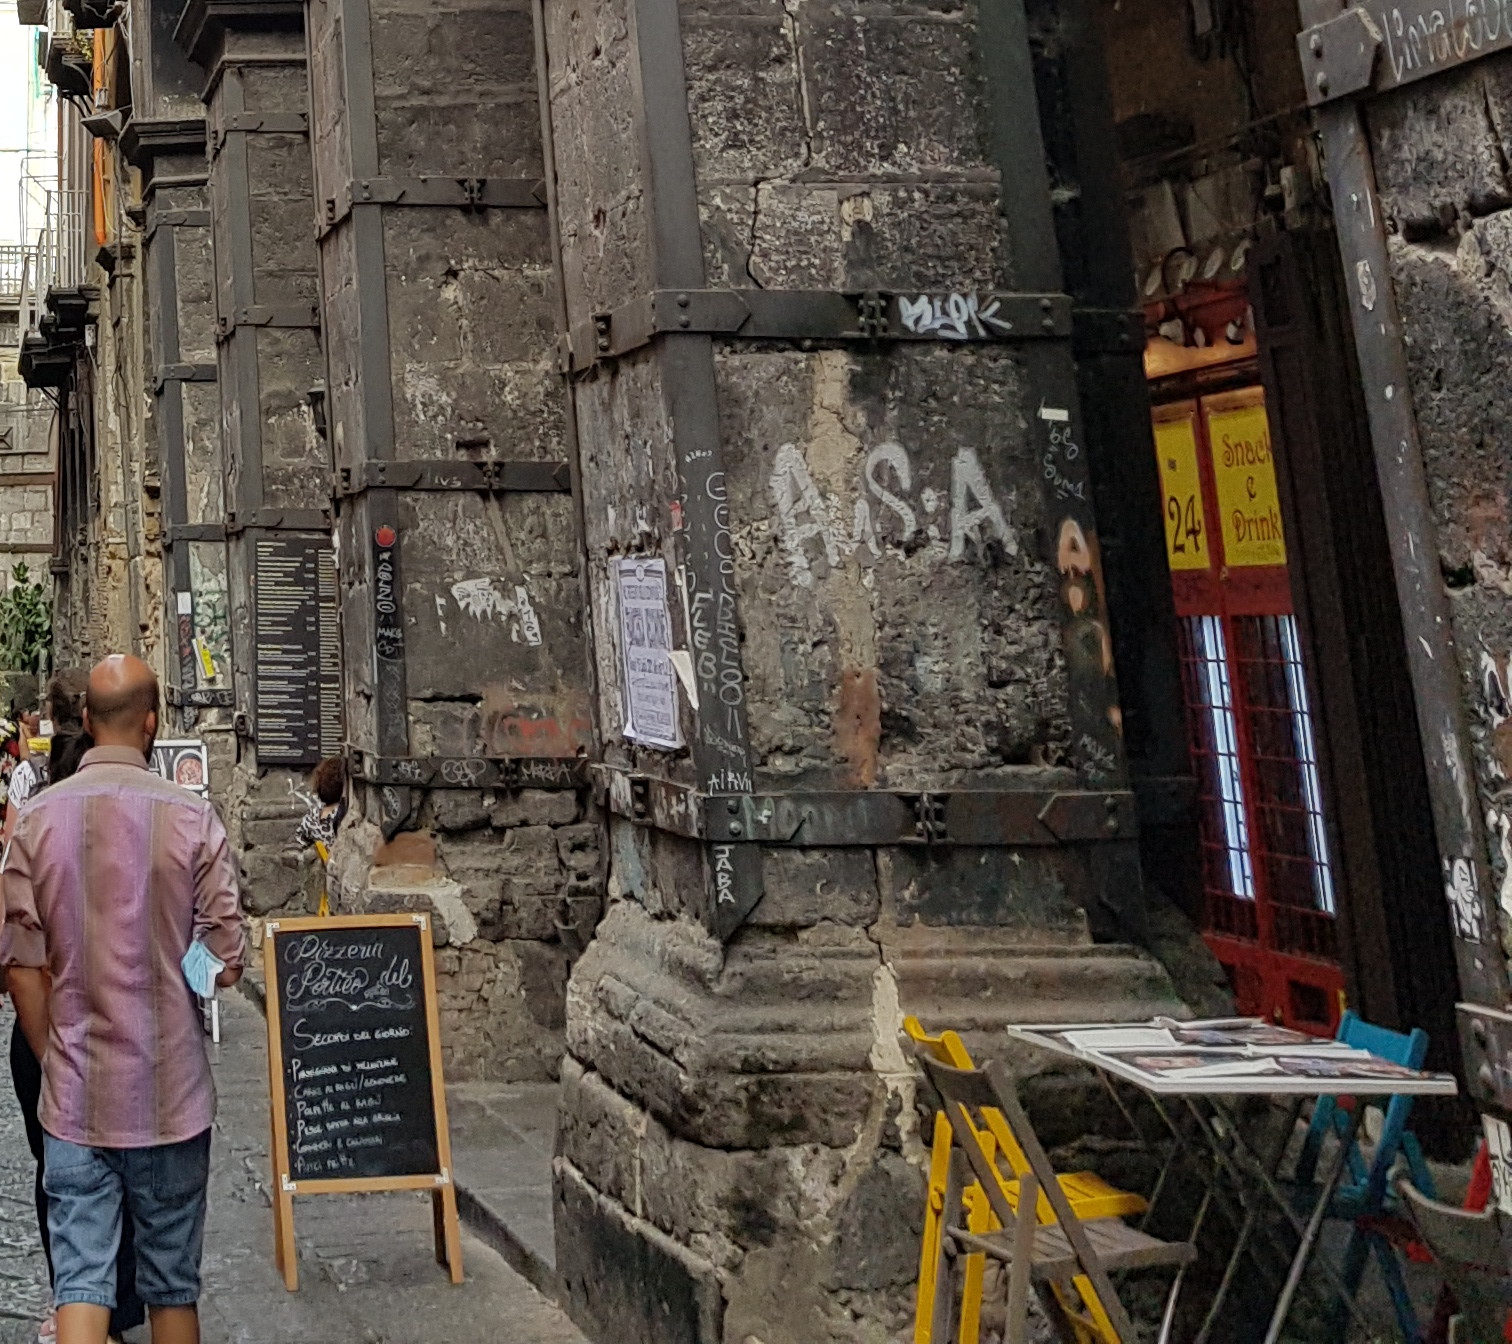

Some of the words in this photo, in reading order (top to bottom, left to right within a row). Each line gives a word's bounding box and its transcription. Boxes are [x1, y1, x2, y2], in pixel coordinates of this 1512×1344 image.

[1168, 493, 1201, 554] 24
[1231, 505, 1282, 543] Drink
[285, 934, 384, 964] Pizzeria
